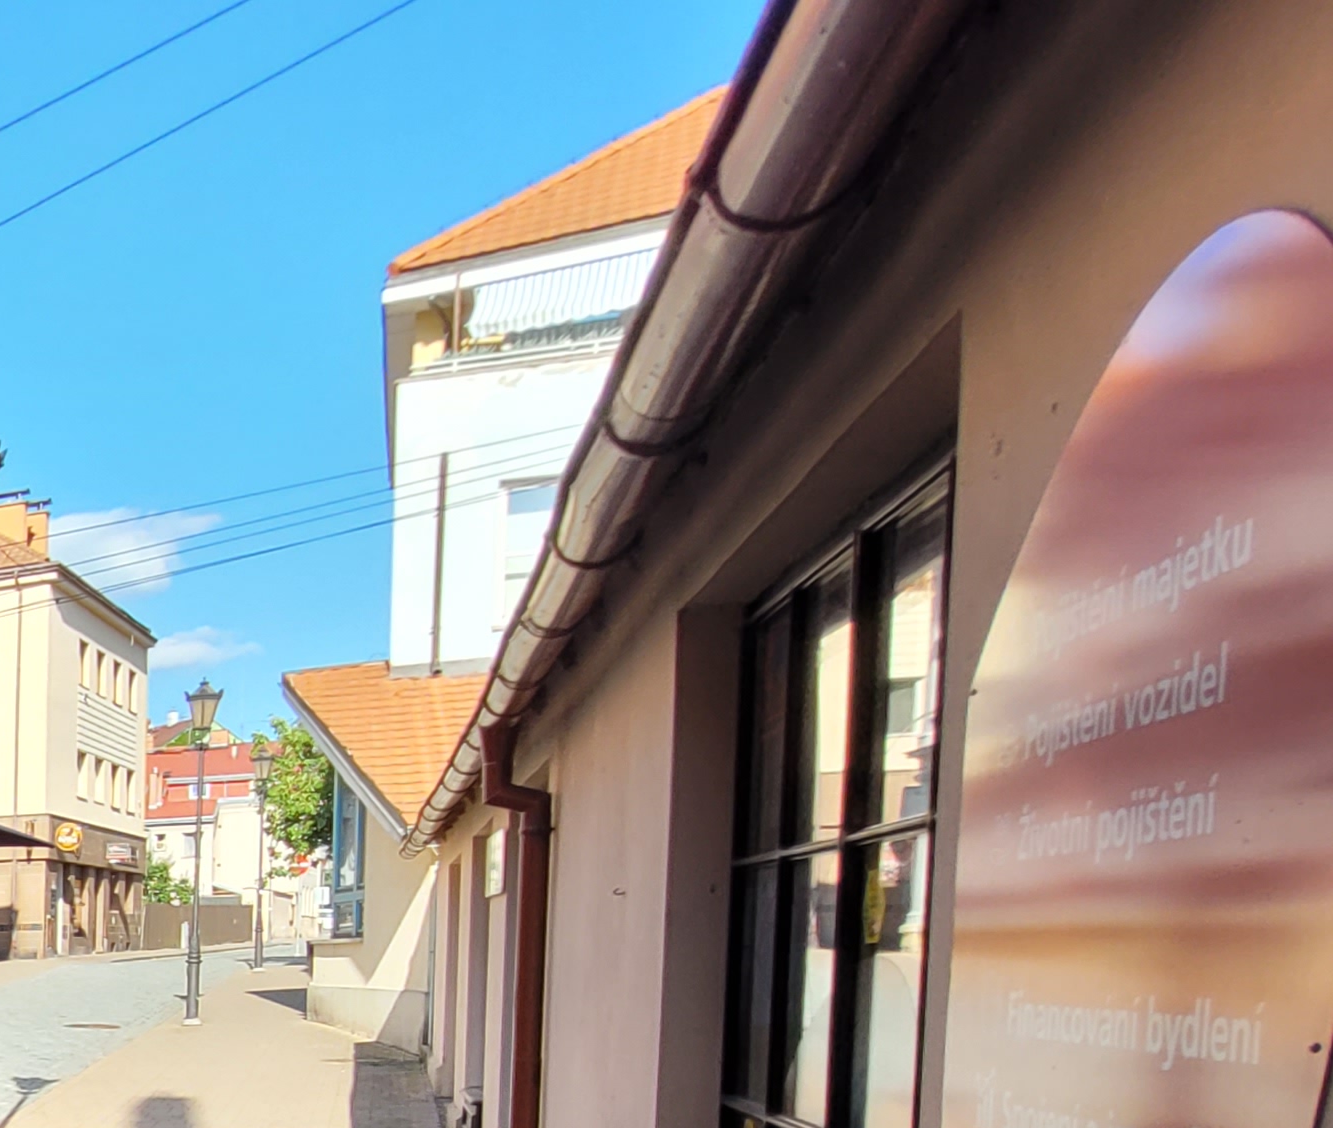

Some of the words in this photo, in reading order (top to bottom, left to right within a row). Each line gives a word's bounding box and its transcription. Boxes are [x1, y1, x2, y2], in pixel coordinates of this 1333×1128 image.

[1031, 562, 1129, 661] Pojištění
[1133, 514, 1254, 613] majetku
[1023, 682, 1119, 769] Pojištění
[1124, 641, 1229, 731] vozidel
[1017, 799, 1094, 862] Životní
[1096, 772, 1220, 865] pojištění
[1007, 989, 1141, 1050] Financování
[1146, 994, 1266, 1071] bydlení
